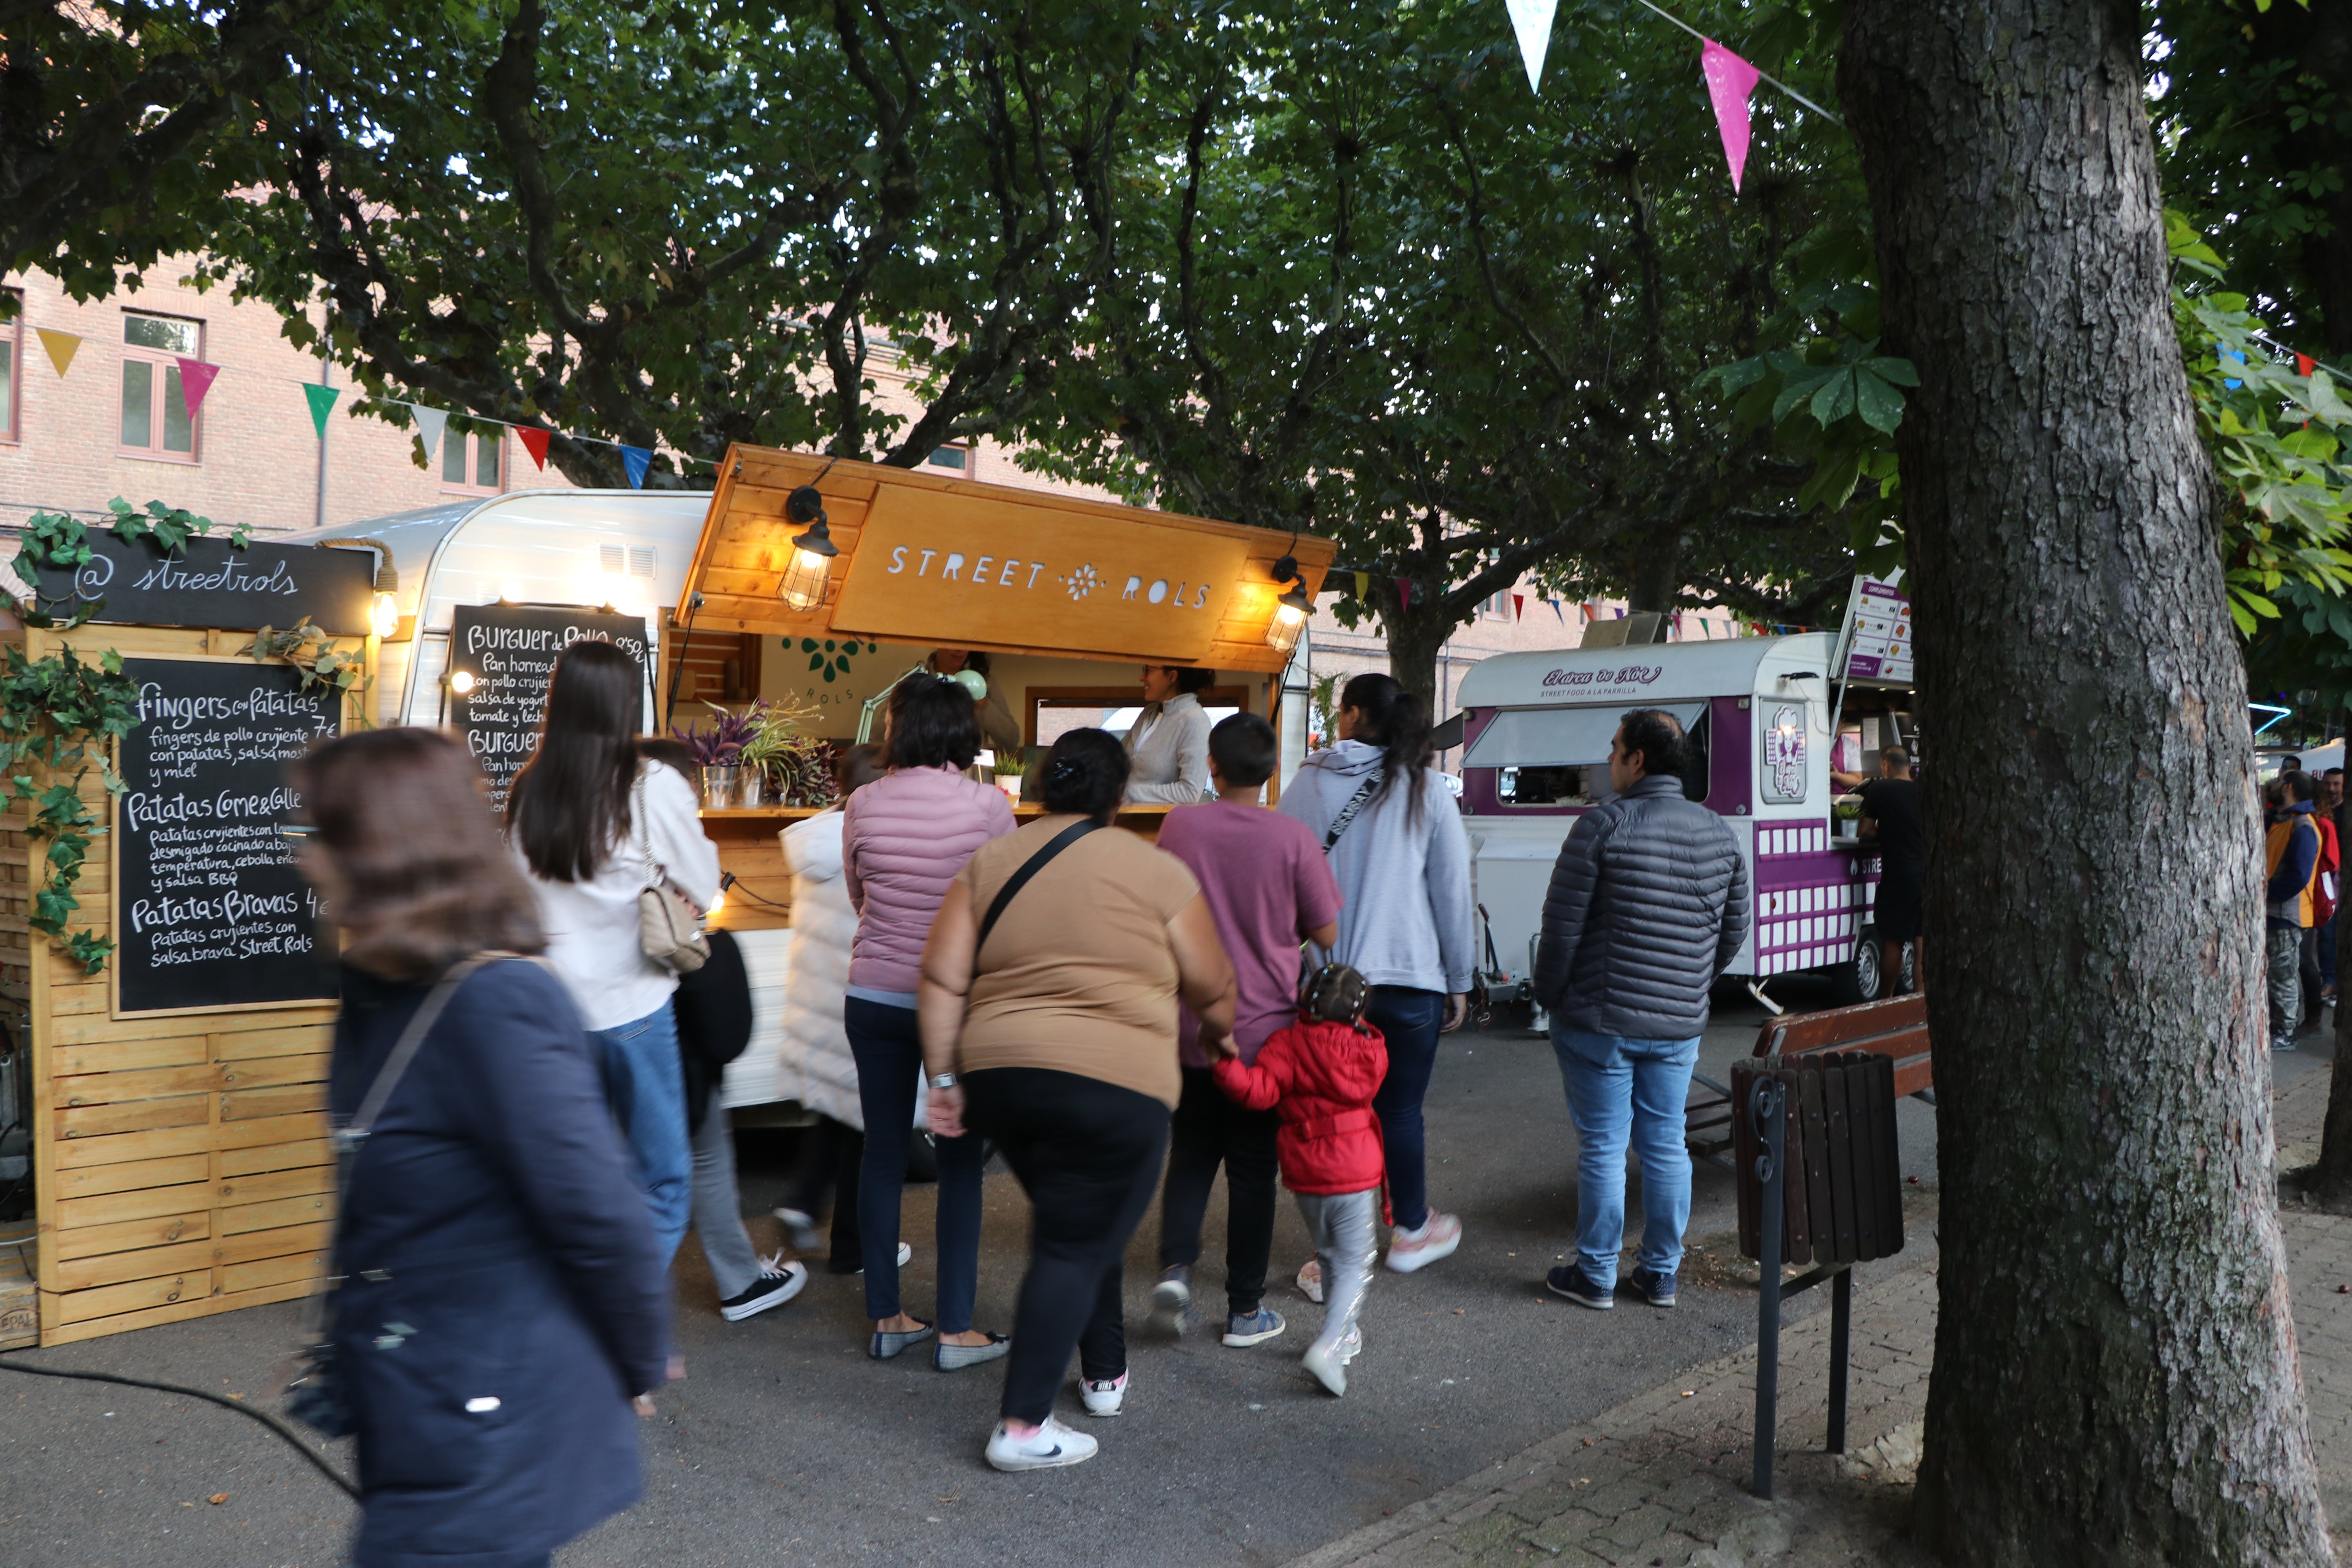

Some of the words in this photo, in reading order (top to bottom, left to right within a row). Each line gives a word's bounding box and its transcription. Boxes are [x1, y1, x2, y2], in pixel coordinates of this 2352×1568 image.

[75, 554, 114, 601] @
[132, 555, 298, 595] streetrols
[887, 545, 1045, 588] STREET
[1122, 575, 1210, 608] ROLS
[552, 633, 563, 651] de
[483, 652, 506, 672] Pan
[510, 654, 557, 673] hornead
[472, 677, 490, 686] on
[492, 673, 516, 693] pollo
[1559, 671, 1594, 685] arca
[1596, 668, 1614, 682] de
[467, 690, 501, 705] salsa
[503, 691, 515, 704] de
[517, 692, 550, 711] yogurt
[807, 688, 853, 704] ROLS
[1603, 686, 1636, 695] PARRILLA
[250, 687, 318, 721] Patatas
[469, 707, 510, 722] tomate
[512, 714, 519, 728] y
[149, 726, 202, 750] fingers
[204, 728, 221, 742] de
[224, 726, 253, 748] pollo
[256, 727, 308, 749] crujiente
[150, 751, 174, 762] con
[278, 746, 310, 759] most
[482, 756, 503, 771] Pan
[150, 768, 161, 788] y
[164, 762, 197, 778] miel
[128, 792, 212, 832] Patatas
[203, 824, 254, 843] crujientes
[255, 826, 273, 836] con
[149, 842, 214, 862] desmigado
[216, 838, 265, 852] cocinado
[276, 855, 301, 864] encu
[1862, 857, 1882, 874] STRE
[151, 878, 163, 893] y
[165, 873, 204, 887] salsa
[208, 871, 238, 886] BBQ
[132, 897, 223, 933] Patatas
[224, 889, 298, 926] Bravas
[210, 921, 273, 946] crujientes
[276, 923, 296, 933] con
[151, 948, 192, 967] salsa
[192, 946, 237, 960] brava
[239, 936, 283, 960] Street
[284, 933, 313, 955] Rols
[1097, 1381, 1113, 1392] NIKE
